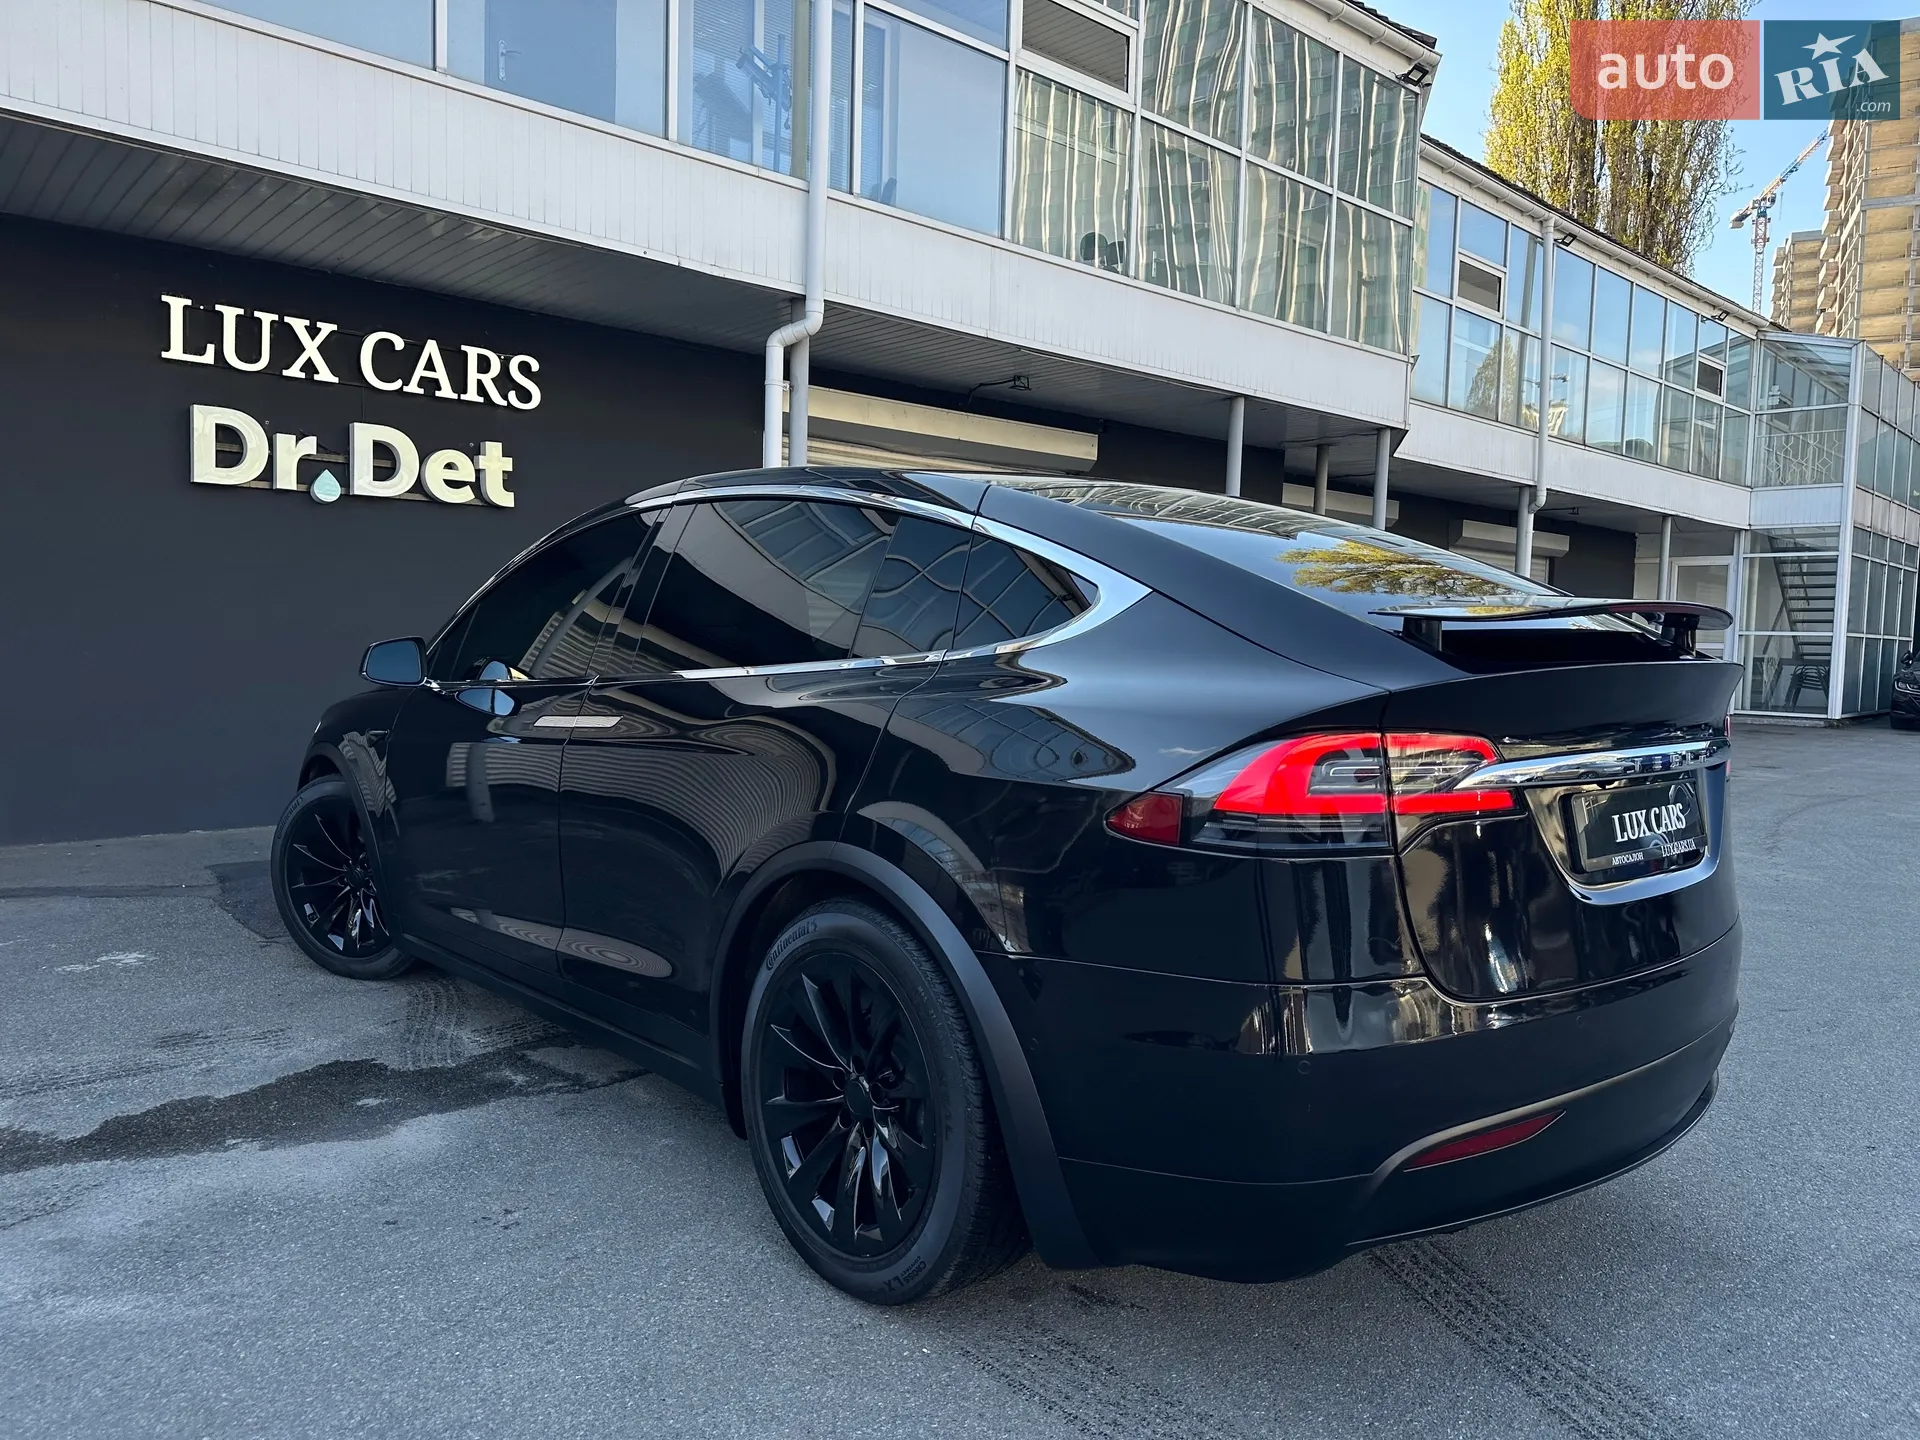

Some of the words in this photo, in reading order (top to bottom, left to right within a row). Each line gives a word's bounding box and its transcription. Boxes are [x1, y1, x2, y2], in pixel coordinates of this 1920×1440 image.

[161, 294, 339, 383] LUX
[360, 331, 542, 410] CARS
[1611, 809, 1651, 843] LUX
[1650, 803, 1686, 834] CARS
[765, 920, 810, 971] Continental
